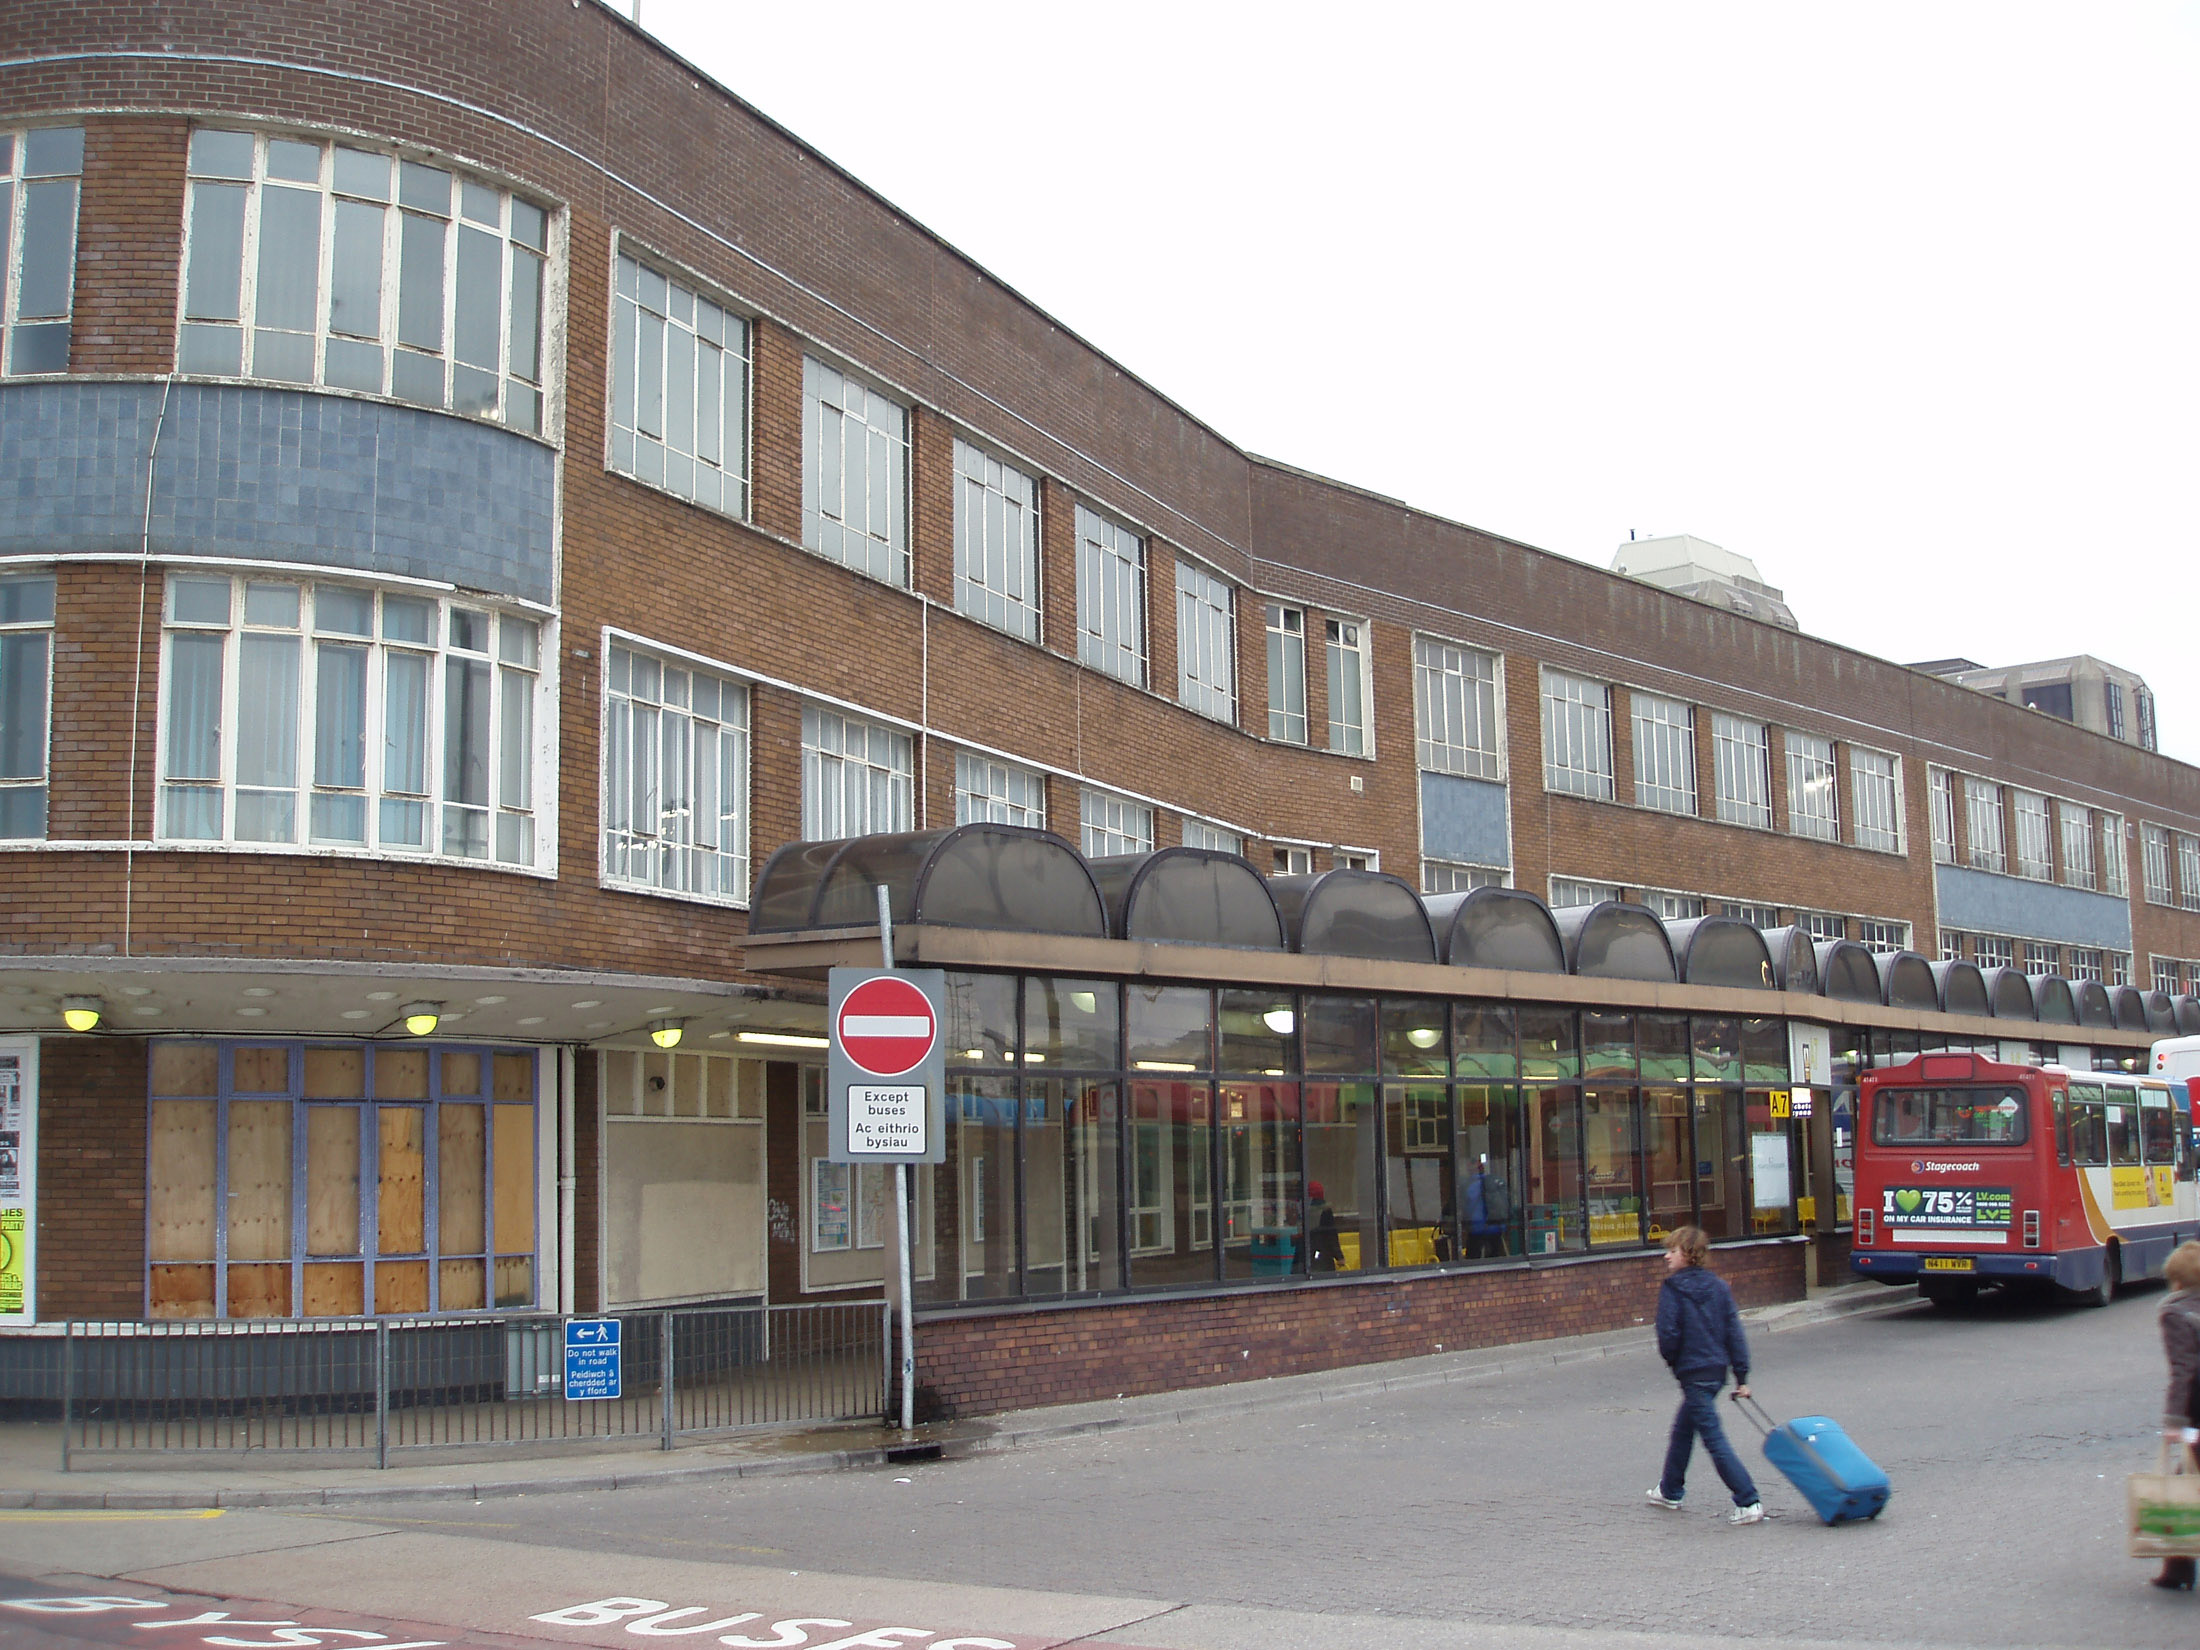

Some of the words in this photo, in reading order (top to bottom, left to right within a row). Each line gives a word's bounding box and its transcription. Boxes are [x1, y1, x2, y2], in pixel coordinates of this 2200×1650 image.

[864, 1091, 909, 1104] Except
[1772, 1094, 1787, 1113] A7
[868, 1104, 906, 1116] buses
[855, 1122, 872, 1134] Ac
[878, 1122, 919, 1134] eithrio
[866, 1136, 908, 1149] bysiau
[1925, 1161, 1980, 1174] Stagecoach
[1883, 1191, 1894, 1212] I
[1976, 1192, 2010, 1201] LV.com
[1883, 1215, 1896, 1223] ON
[1896, 1215, 1909, 1223] MY
[1910, 1215, 1927, 1223] CAR
[1928, 1215, 1972, 1224] INSURANCE
[568, 1349, 579, 1357] Do
[599, 1348, 617, 1356] walk
[589, 1357, 607, 1365] road
[571, 1370, 606, 1378] Peidiwch
[609, 1369, 614, 1377] â
[569, 1379, 605, 1387] cherdded
[587, 1387, 607, 1395] fford
